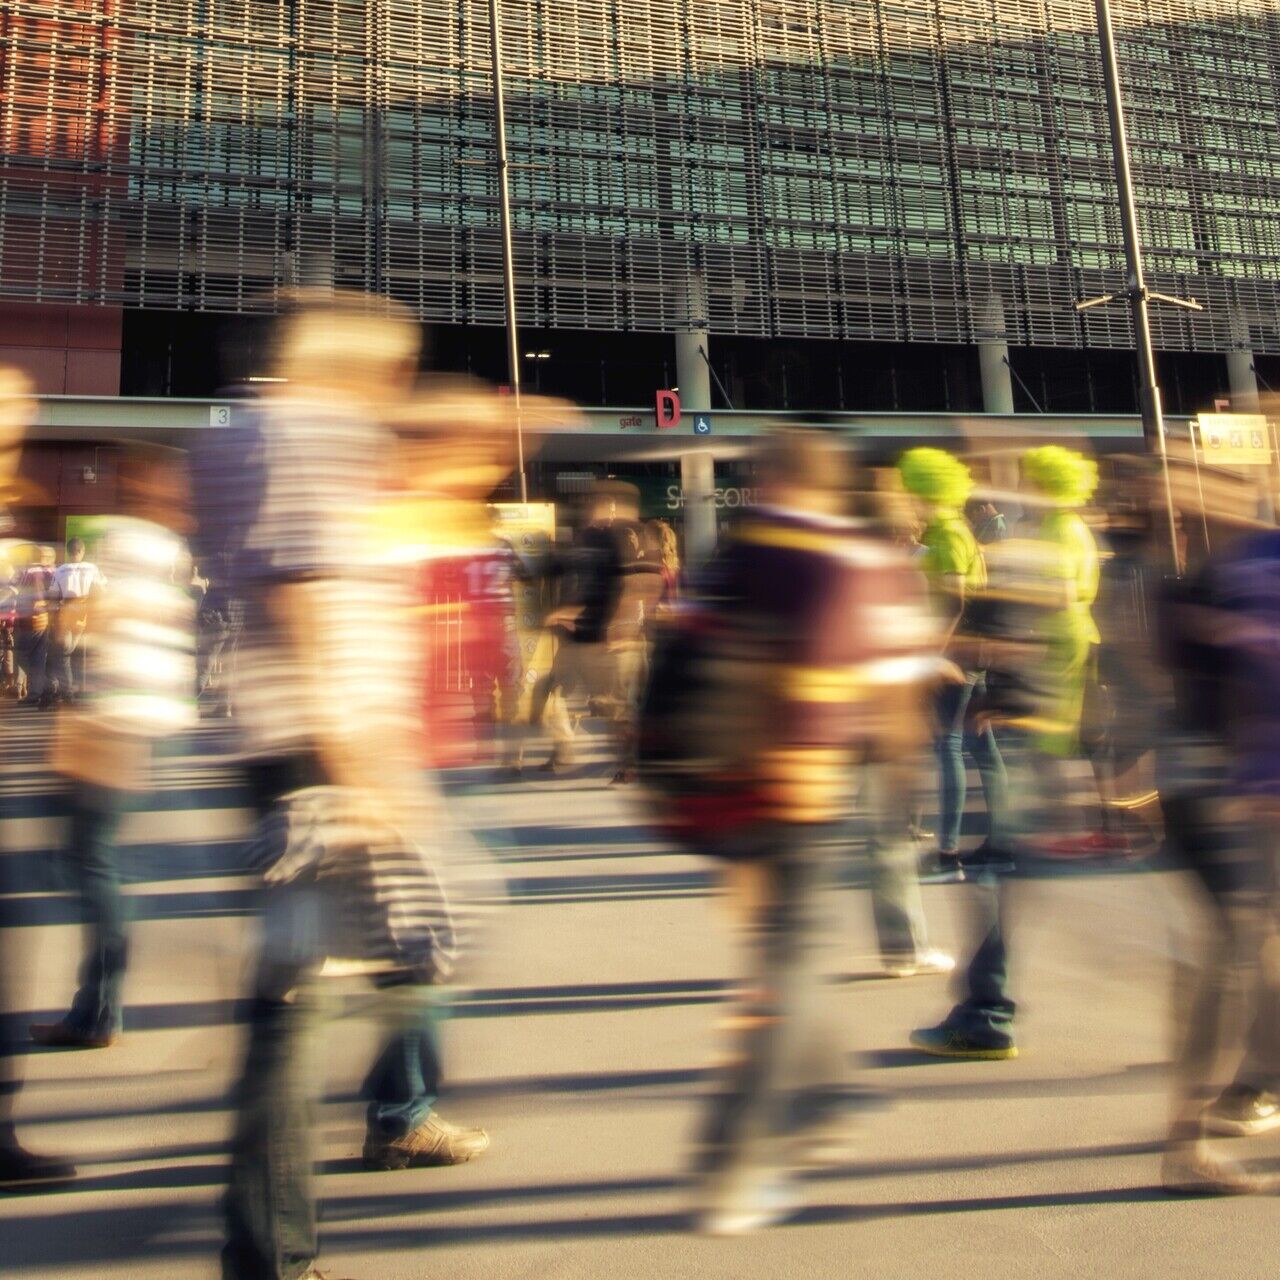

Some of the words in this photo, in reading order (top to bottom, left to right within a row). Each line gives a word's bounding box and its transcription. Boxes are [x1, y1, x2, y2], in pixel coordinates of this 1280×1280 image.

[218, 408, 228, 424] 3
[620, 415, 643, 429] gate
[656, 390, 680, 428] D
